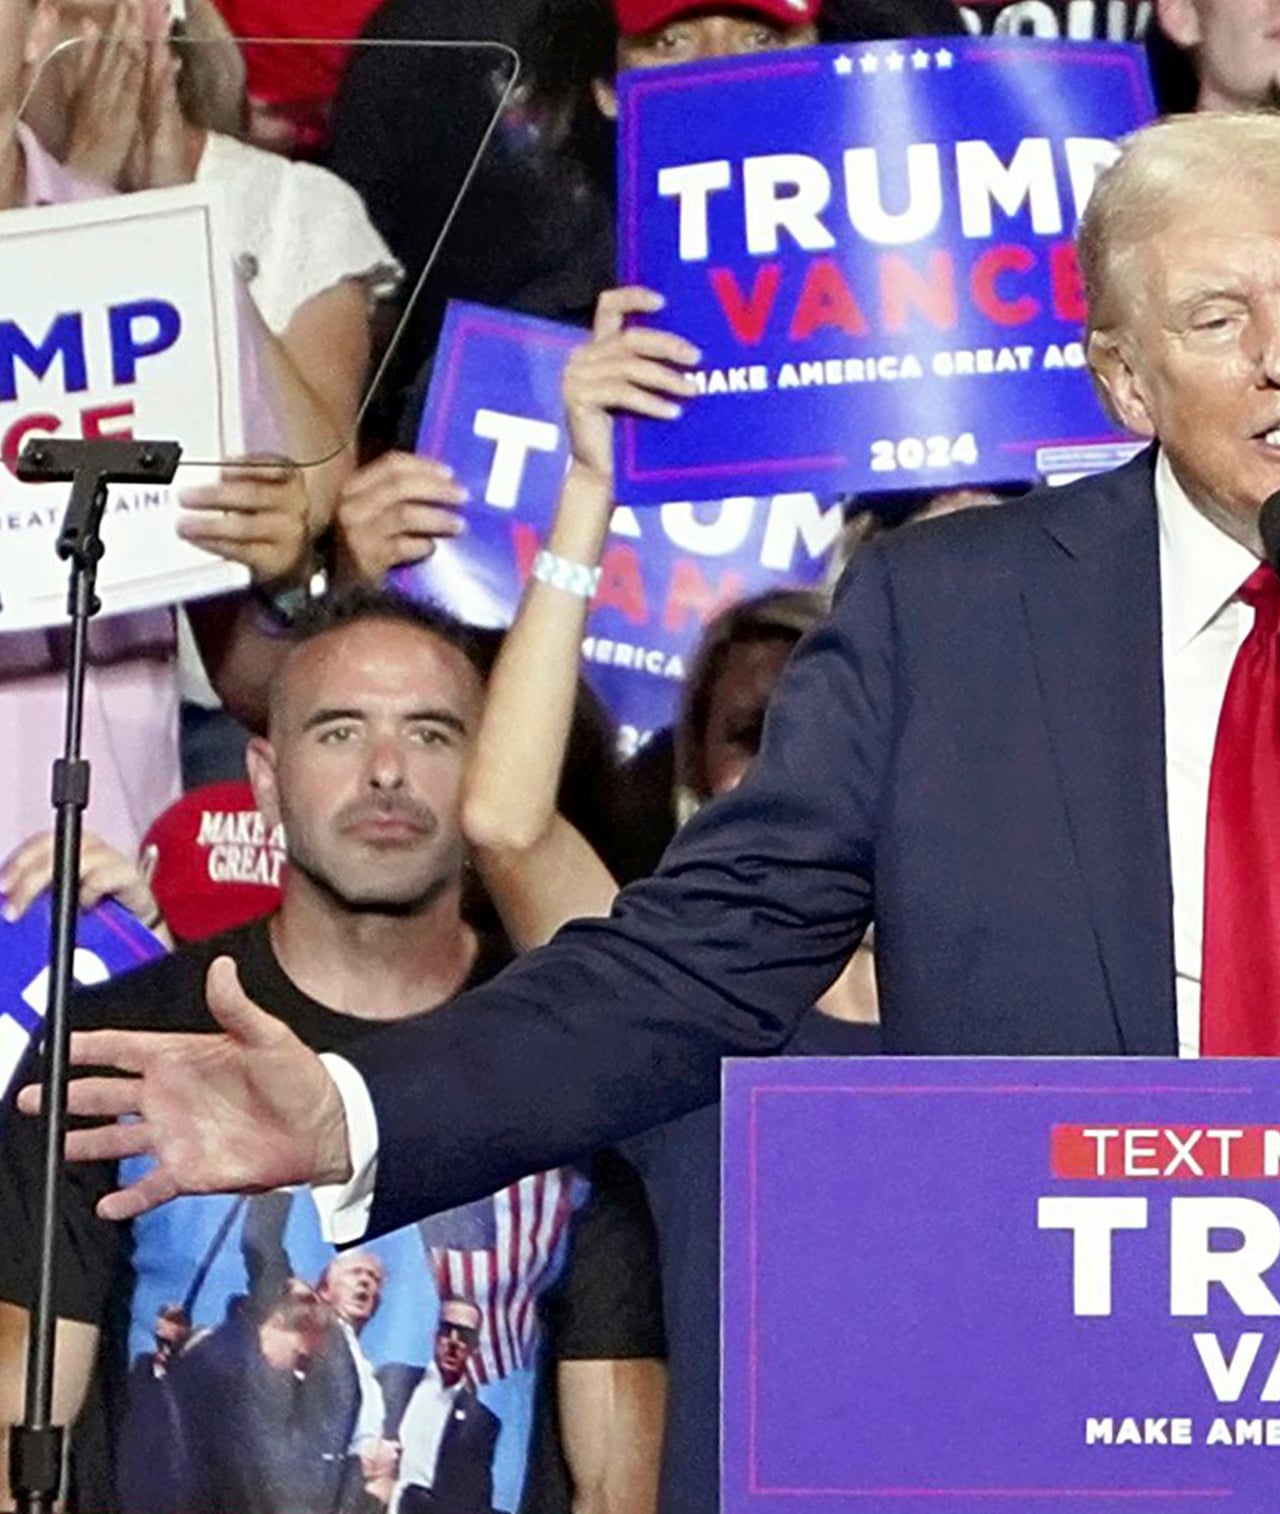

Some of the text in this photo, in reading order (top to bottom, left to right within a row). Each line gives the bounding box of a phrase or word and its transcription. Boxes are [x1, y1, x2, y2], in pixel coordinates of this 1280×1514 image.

[777, 354, 923, 387] AMERICA
[931, 346, 1034, 376] GREAT
[869, 433, 979, 472] 2024
[197, 810, 267, 846] MAKE
[208, 846, 288, 888] GREAT
[1083, 1128, 1243, 1177] TEXT
[1085, 1417, 1192, 1446] MAKE
